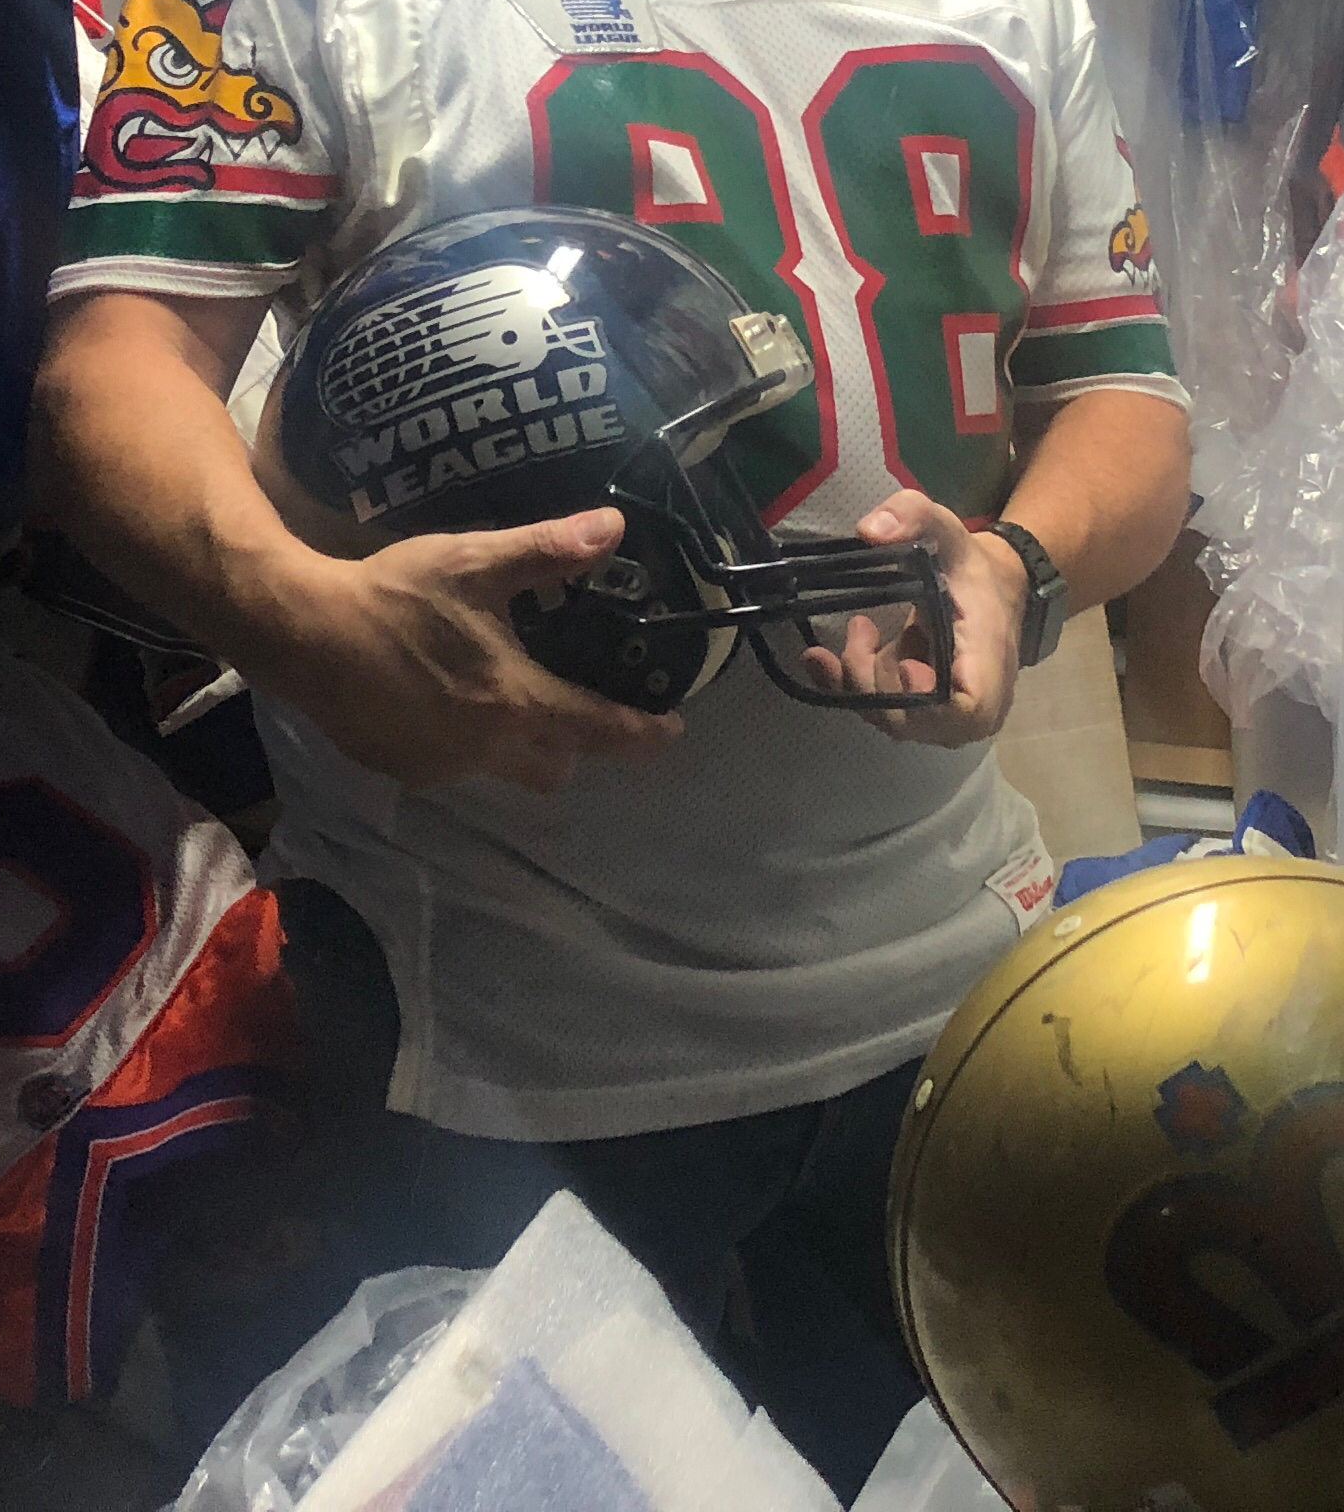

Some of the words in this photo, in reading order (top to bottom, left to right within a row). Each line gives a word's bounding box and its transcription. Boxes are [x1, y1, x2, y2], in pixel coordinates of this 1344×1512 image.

[570, 23, 634, 32] WORLD
[575, 34, 641, 44] LEAGUE
[338, 363, 608, 477] WORLD
[349, 403, 625, 524] LEAGUE
